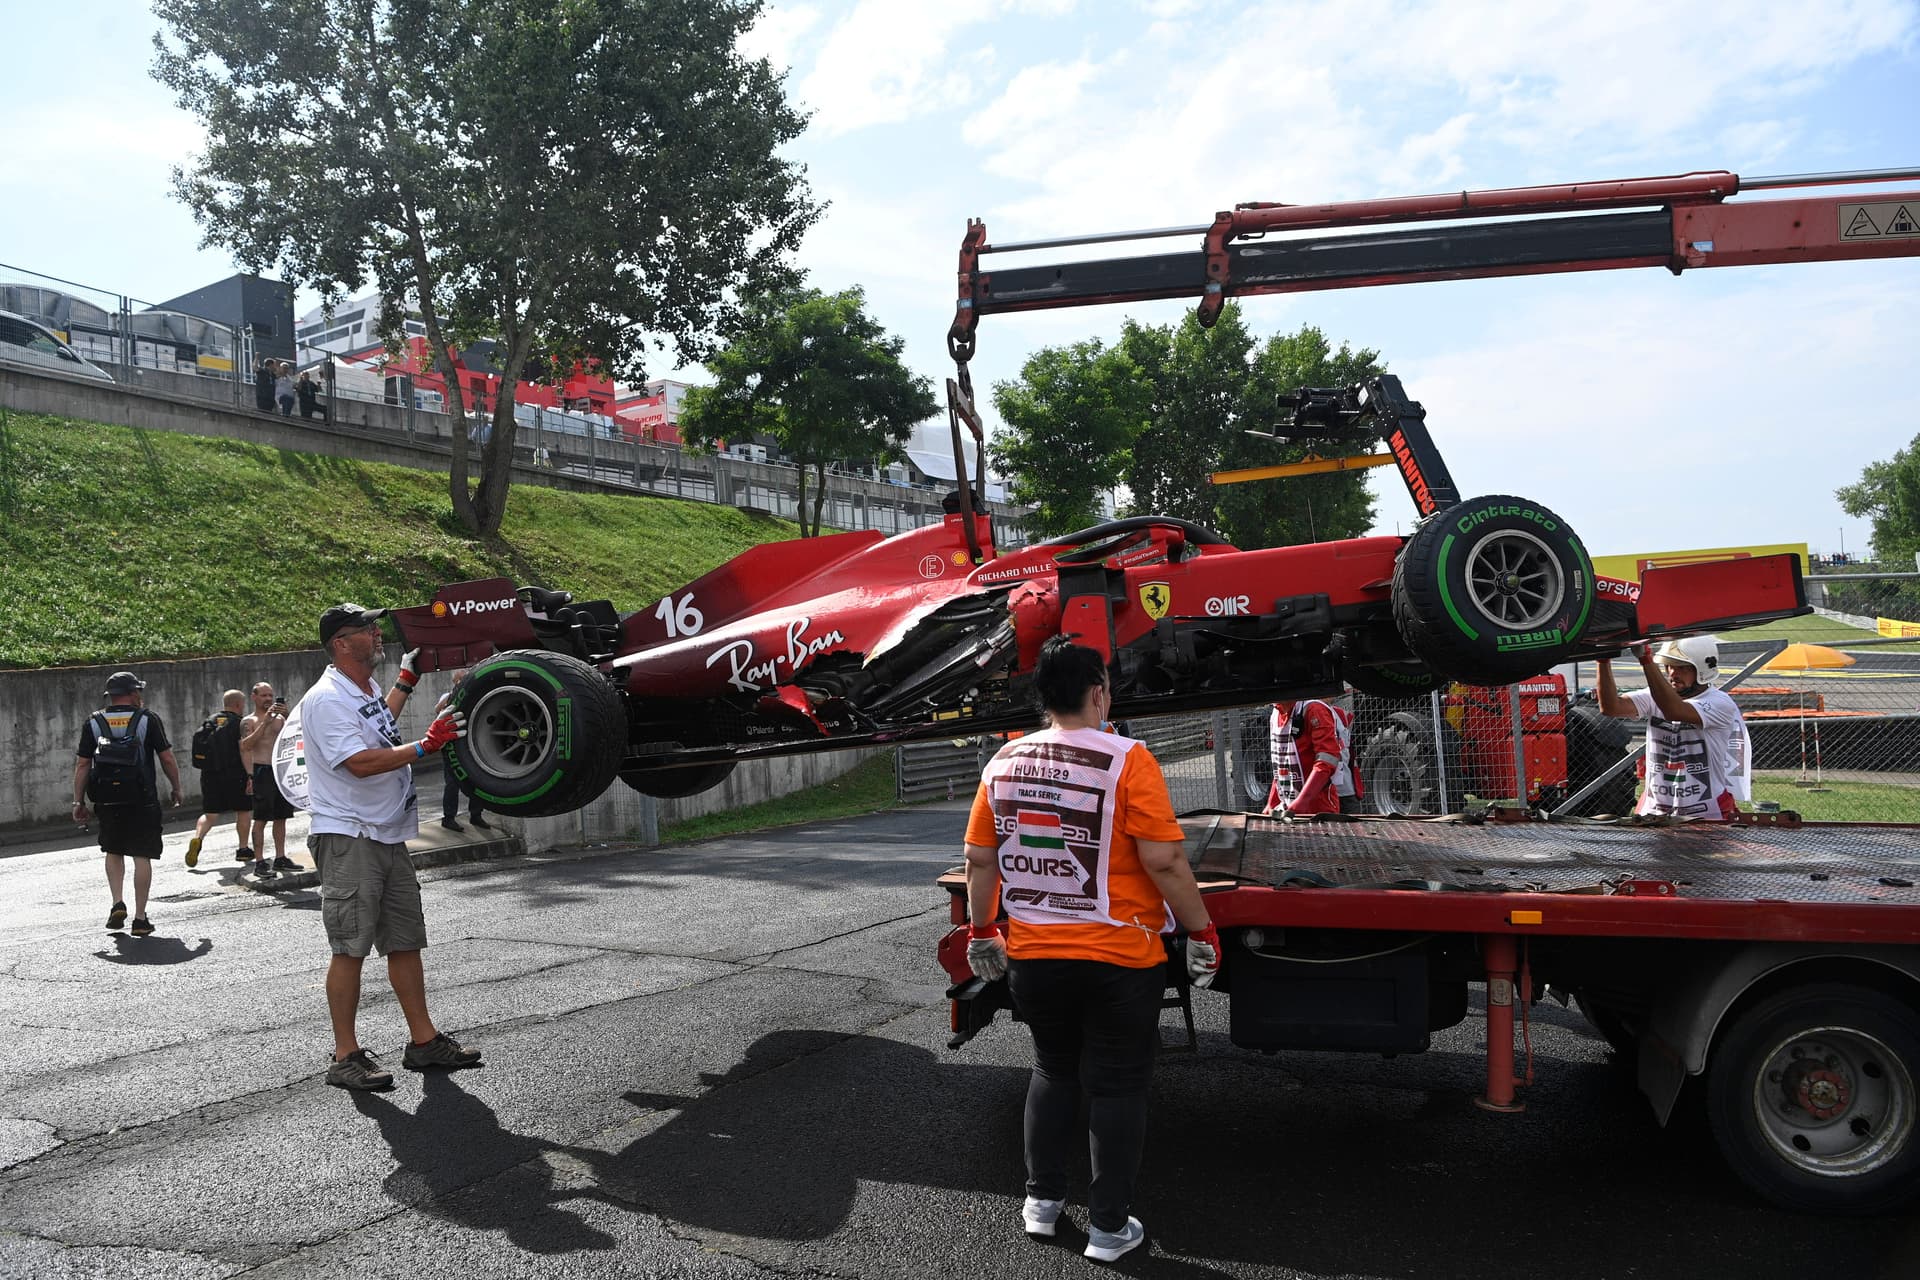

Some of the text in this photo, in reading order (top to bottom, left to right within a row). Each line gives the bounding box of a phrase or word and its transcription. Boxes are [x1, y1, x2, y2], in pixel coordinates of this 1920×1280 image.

[1390, 429, 1437, 515] MANITOU
[977, 563, 1052, 583] RICHARD MILLE
[448, 597, 517, 616] V-Power
[655, 592, 704, 638] 16
[1497, 629, 1562, 652] PIRELLI
[1518, 683, 1556, 692] MANITOU
[557, 698, 571, 760] PIRELLI
[1014, 764, 1069, 780] HUN1529
[1018, 788, 1061, 801] TRACK SERVICE
